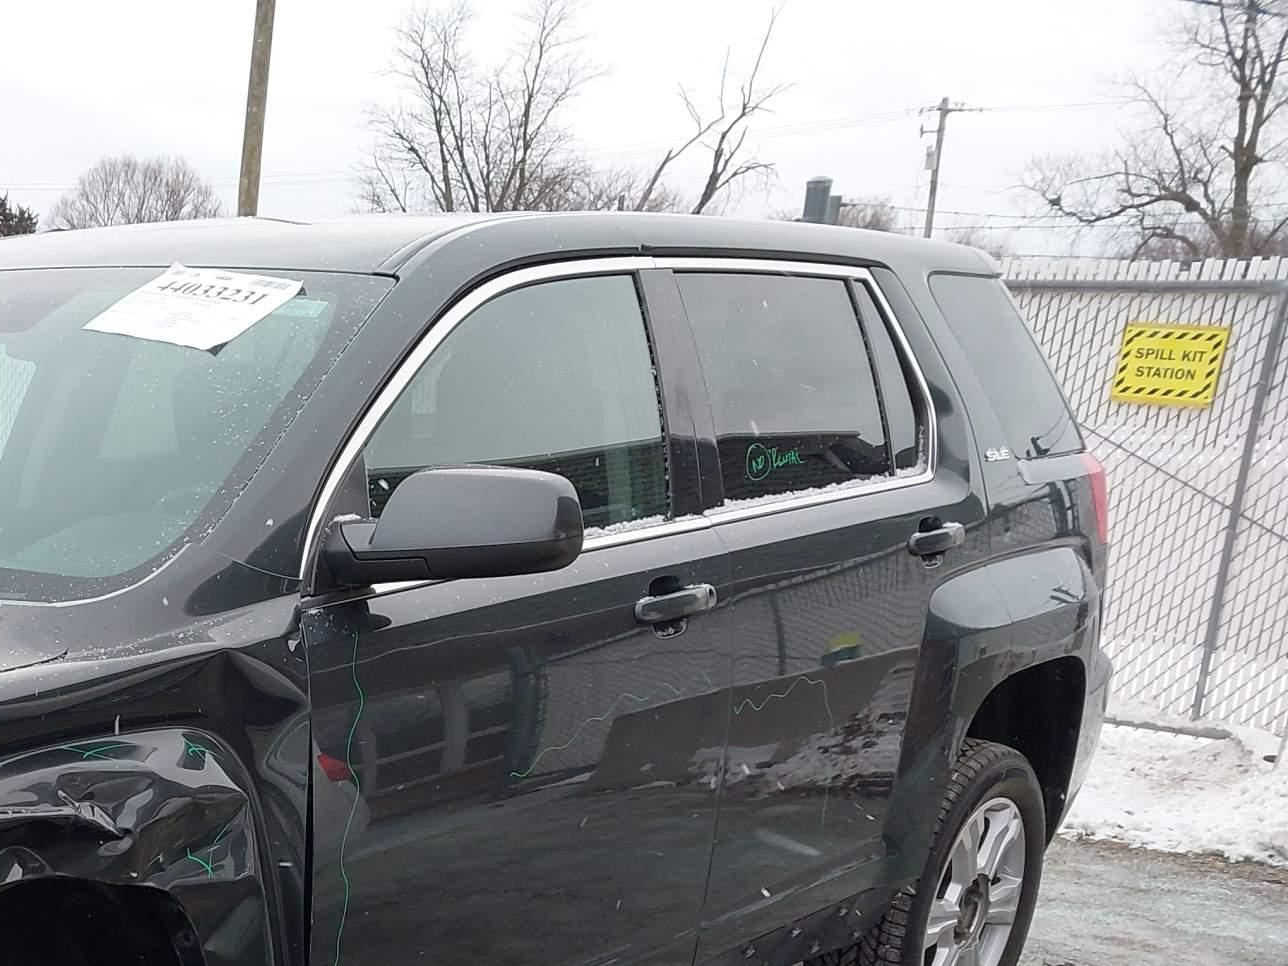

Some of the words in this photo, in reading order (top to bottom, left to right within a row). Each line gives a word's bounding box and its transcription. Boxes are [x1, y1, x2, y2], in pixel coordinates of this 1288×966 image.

[157, 279, 268, 305] 44033231
[1135, 347, 1175, 361] SPILL
[1181, 350, 1207, 363] KIT
[1135, 365, 1196, 380] STATION
[985, 447, 1010, 462] SLE
